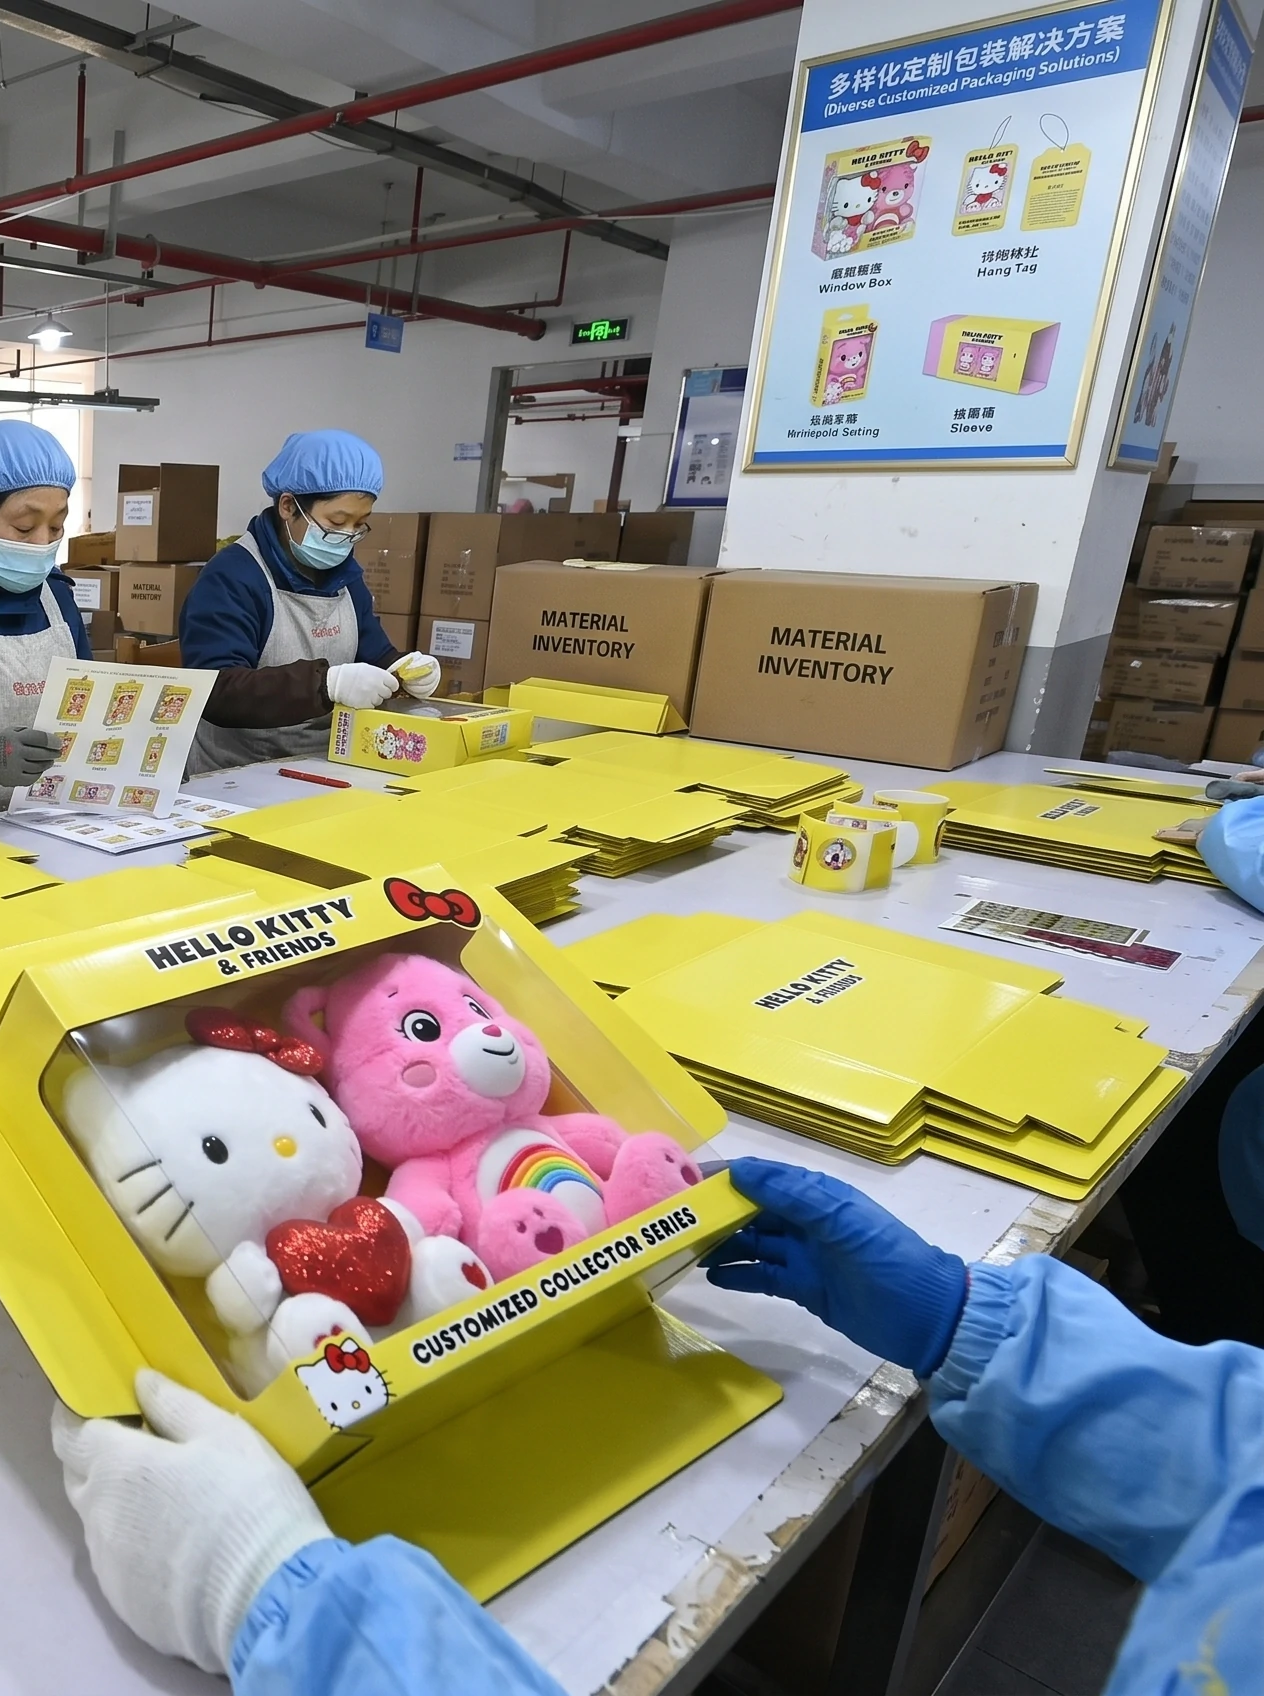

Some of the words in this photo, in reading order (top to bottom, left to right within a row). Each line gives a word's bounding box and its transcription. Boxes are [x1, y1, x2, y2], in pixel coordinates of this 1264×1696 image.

[828, 14, 1126, 100] 多样化定制包装解决方案
[824, 96, 876, 118] (Diverse
[878, 80, 957, 105] Customized
[961, 65, 1035, 91] Packaging
[1038, 47, 1120, 76] Solutions)
[977, 266, 1011, 277] Hang
[1015, 263, 1037, 274] Tag
[819, 281, 866, 293] Window
[869, 277, 892, 288] Box
[950, 423, 993, 433] Sleeve
[131, 593, 162, 601] INVENTORY
[133, 584, 162, 592] MATERIAL
[541, 610, 629, 632] MATERIAL
[532, 634, 635, 659] INVENTORY
[770, 626, 886, 654] MATERIAL
[758, 655, 894, 685] INVENTORY
[145, 925, 255, 970] HELLO
[255, 898, 353, 939] KITTY
[218, 959, 240, 976] &
[240, 931, 336, 969] FRIENDS
[754, 983, 812, 1010] HELLO
[801, 959, 855, 984] KITTY
[412, 1288, 538, 1364] CUSTOMIZED
[540, 1235, 643, 1298] COLLECTOR
[640, 1207, 697, 1246] SERIES
